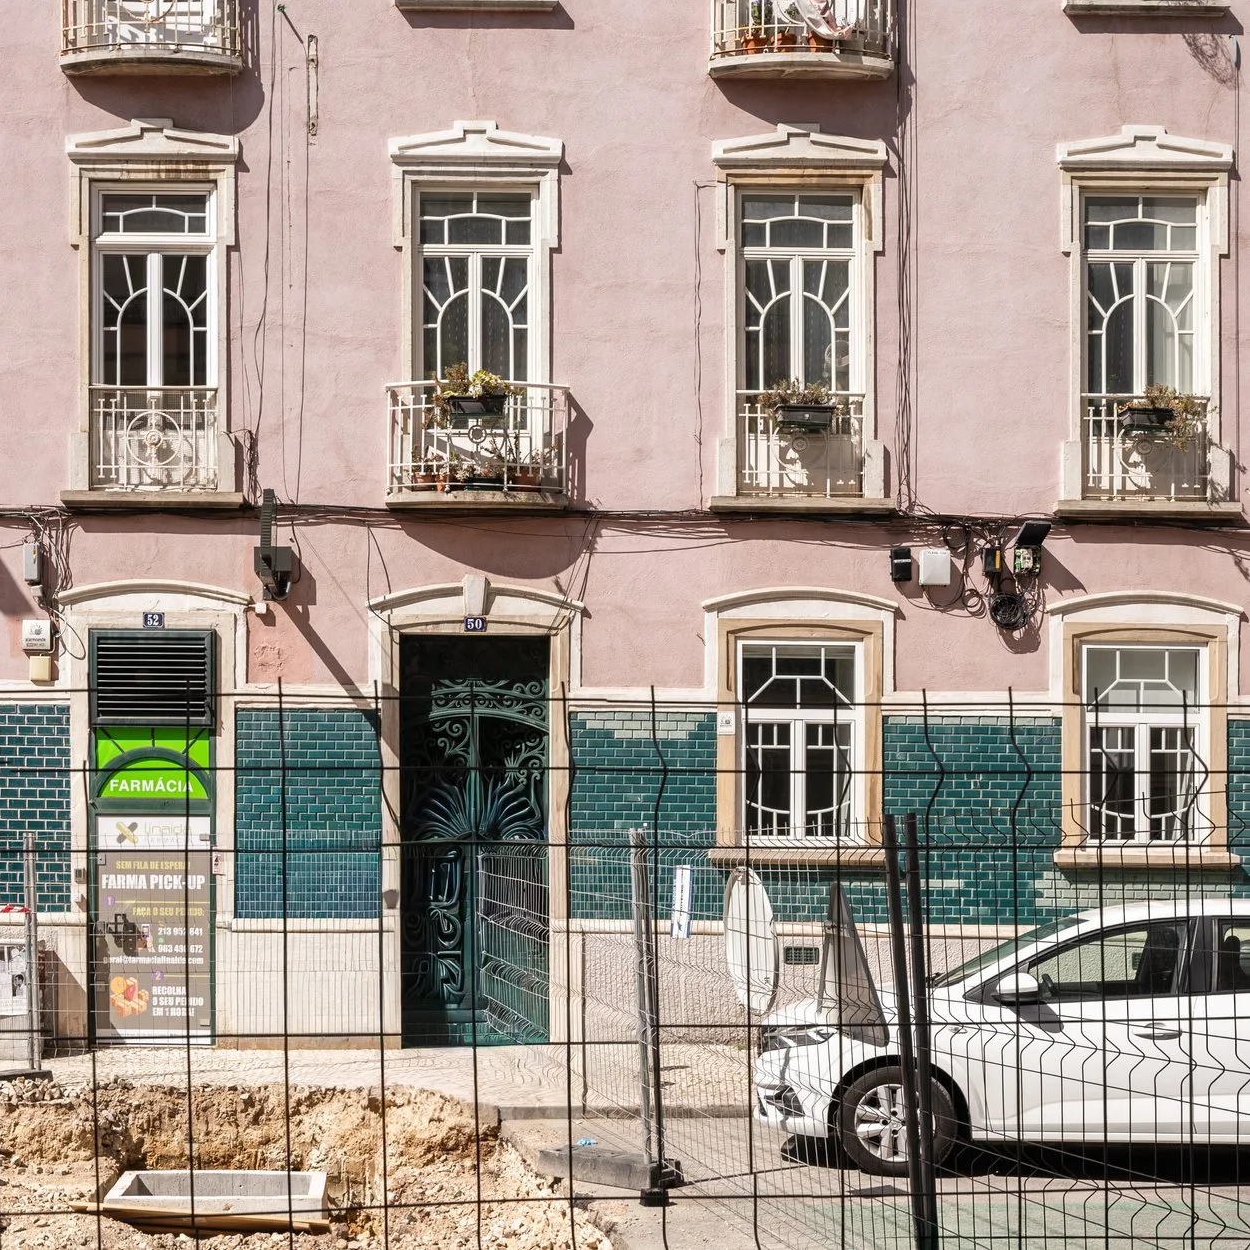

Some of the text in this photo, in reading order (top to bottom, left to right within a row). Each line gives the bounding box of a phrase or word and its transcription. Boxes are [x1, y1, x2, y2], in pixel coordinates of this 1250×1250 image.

[146, 614, 160, 626] 52
[467, 618, 483, 630] 50
[110, 776, 194, 793] FARMÁCIA
[115, 860, 131, 870] SEM
[132, 860, 149, 870] FILA
[150, 860, 159, 870] DE
[101, 873, 206, 890] FARMA PICK-UP
[132, 906, 205, 918] FAÇA O SEU PEIDO:
[152, 985, 187, 996] RECOLHA
[152, 996, 158, 1006] O
[158, 996, 174, 1006] SEU
[152, 1007, 164, 1017] EM
